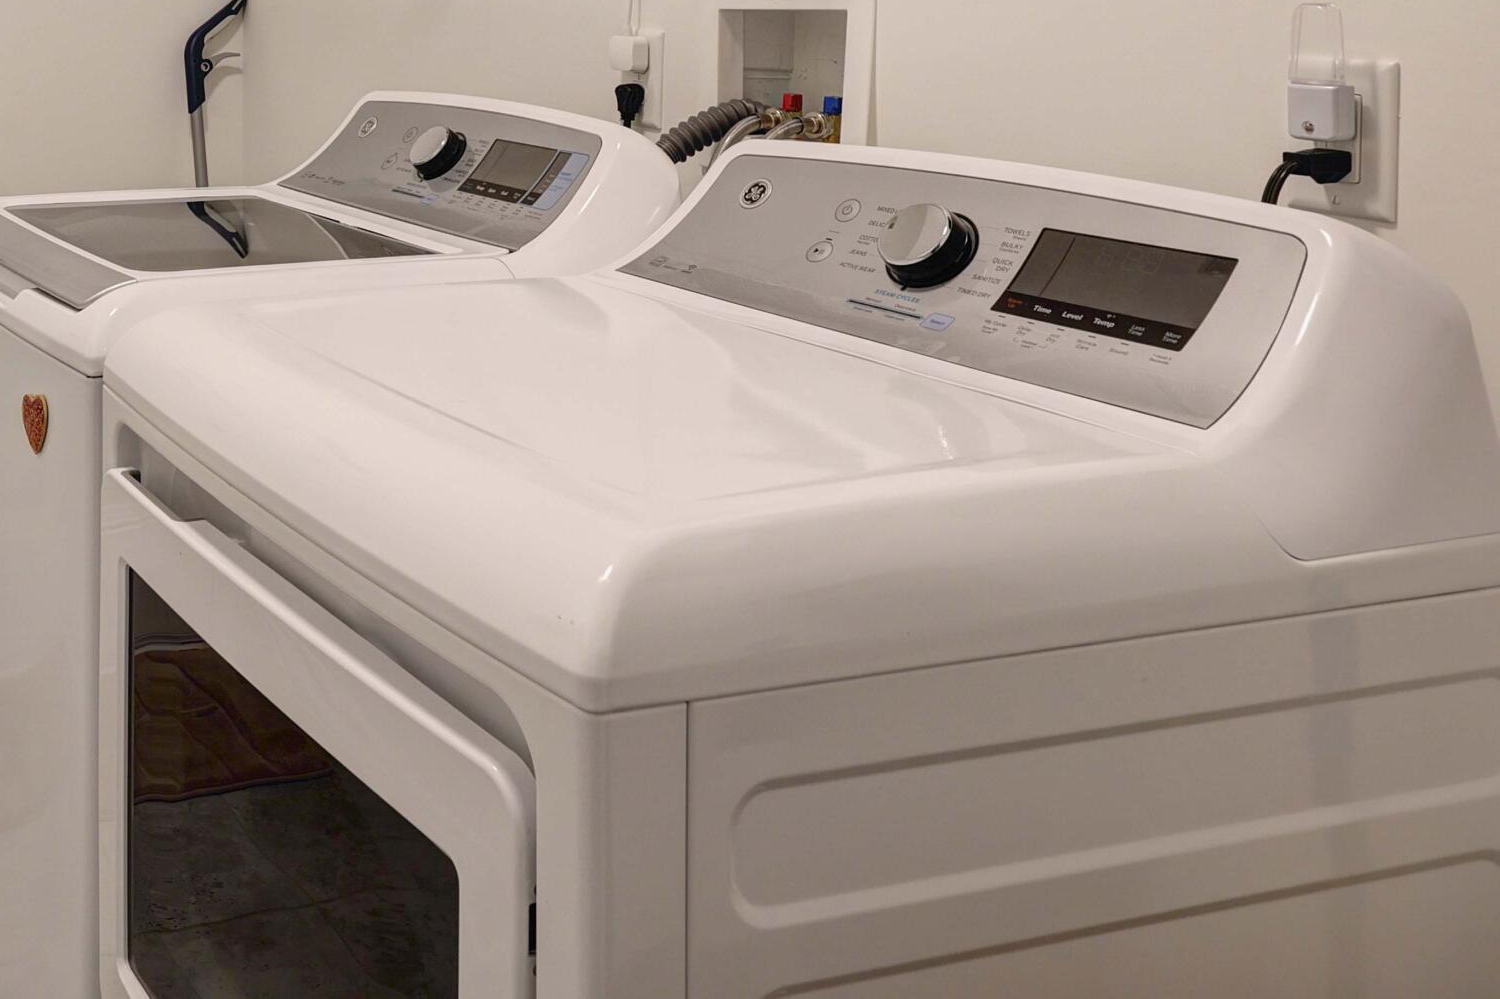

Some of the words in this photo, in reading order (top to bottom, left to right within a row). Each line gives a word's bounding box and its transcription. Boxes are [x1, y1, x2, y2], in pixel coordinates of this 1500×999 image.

[1004, 227, 1031, 237] TOWELS
[992, 257, 1013, 267] QUICK
[1033, 305, 1052, 315] Time
[1061, 310, 1084, 321] Level
[1093, 317, 1115, 328] Temp
